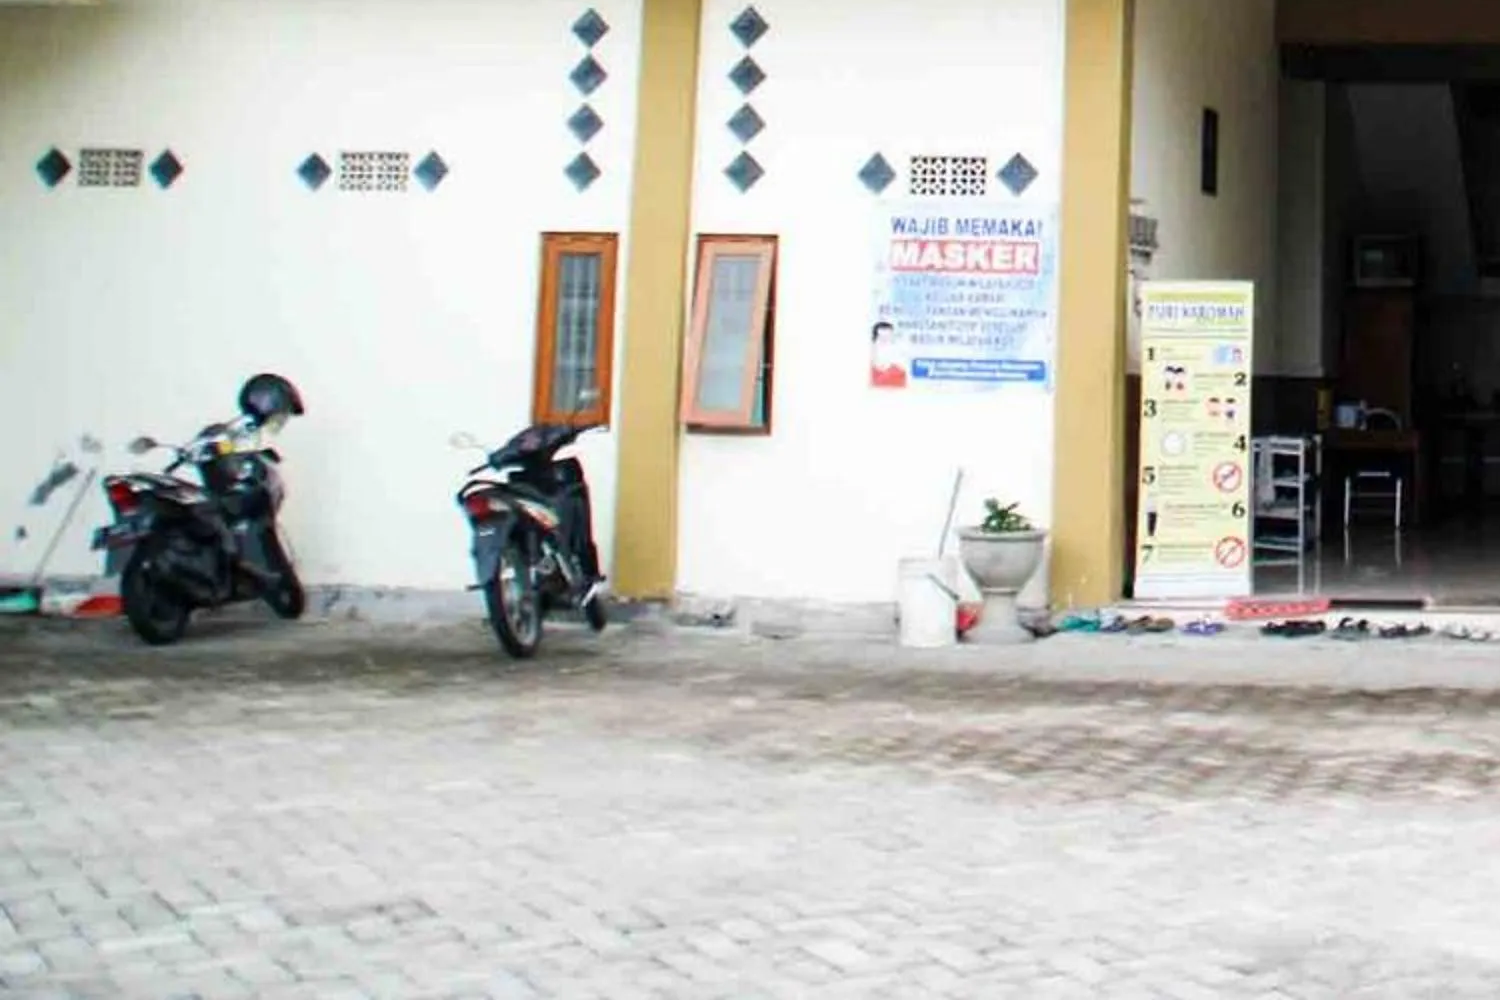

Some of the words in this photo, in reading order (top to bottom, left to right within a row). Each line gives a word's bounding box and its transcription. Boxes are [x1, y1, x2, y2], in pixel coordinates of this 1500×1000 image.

[891, 216, 949, 235] WAJIB
[891, 240, 1037, 272] MASKER
[1147, 347, 1155, 361] 1
[1233, 371, 1247, 387] 2
[1143, 399, 1157, 417] 3
[1233, 434, 1246, 453] 4
[1141, 465, 1156, 485] 5
[1231, 501, 1246, 519] 6
[1140, 543, 1154, 566] 7
